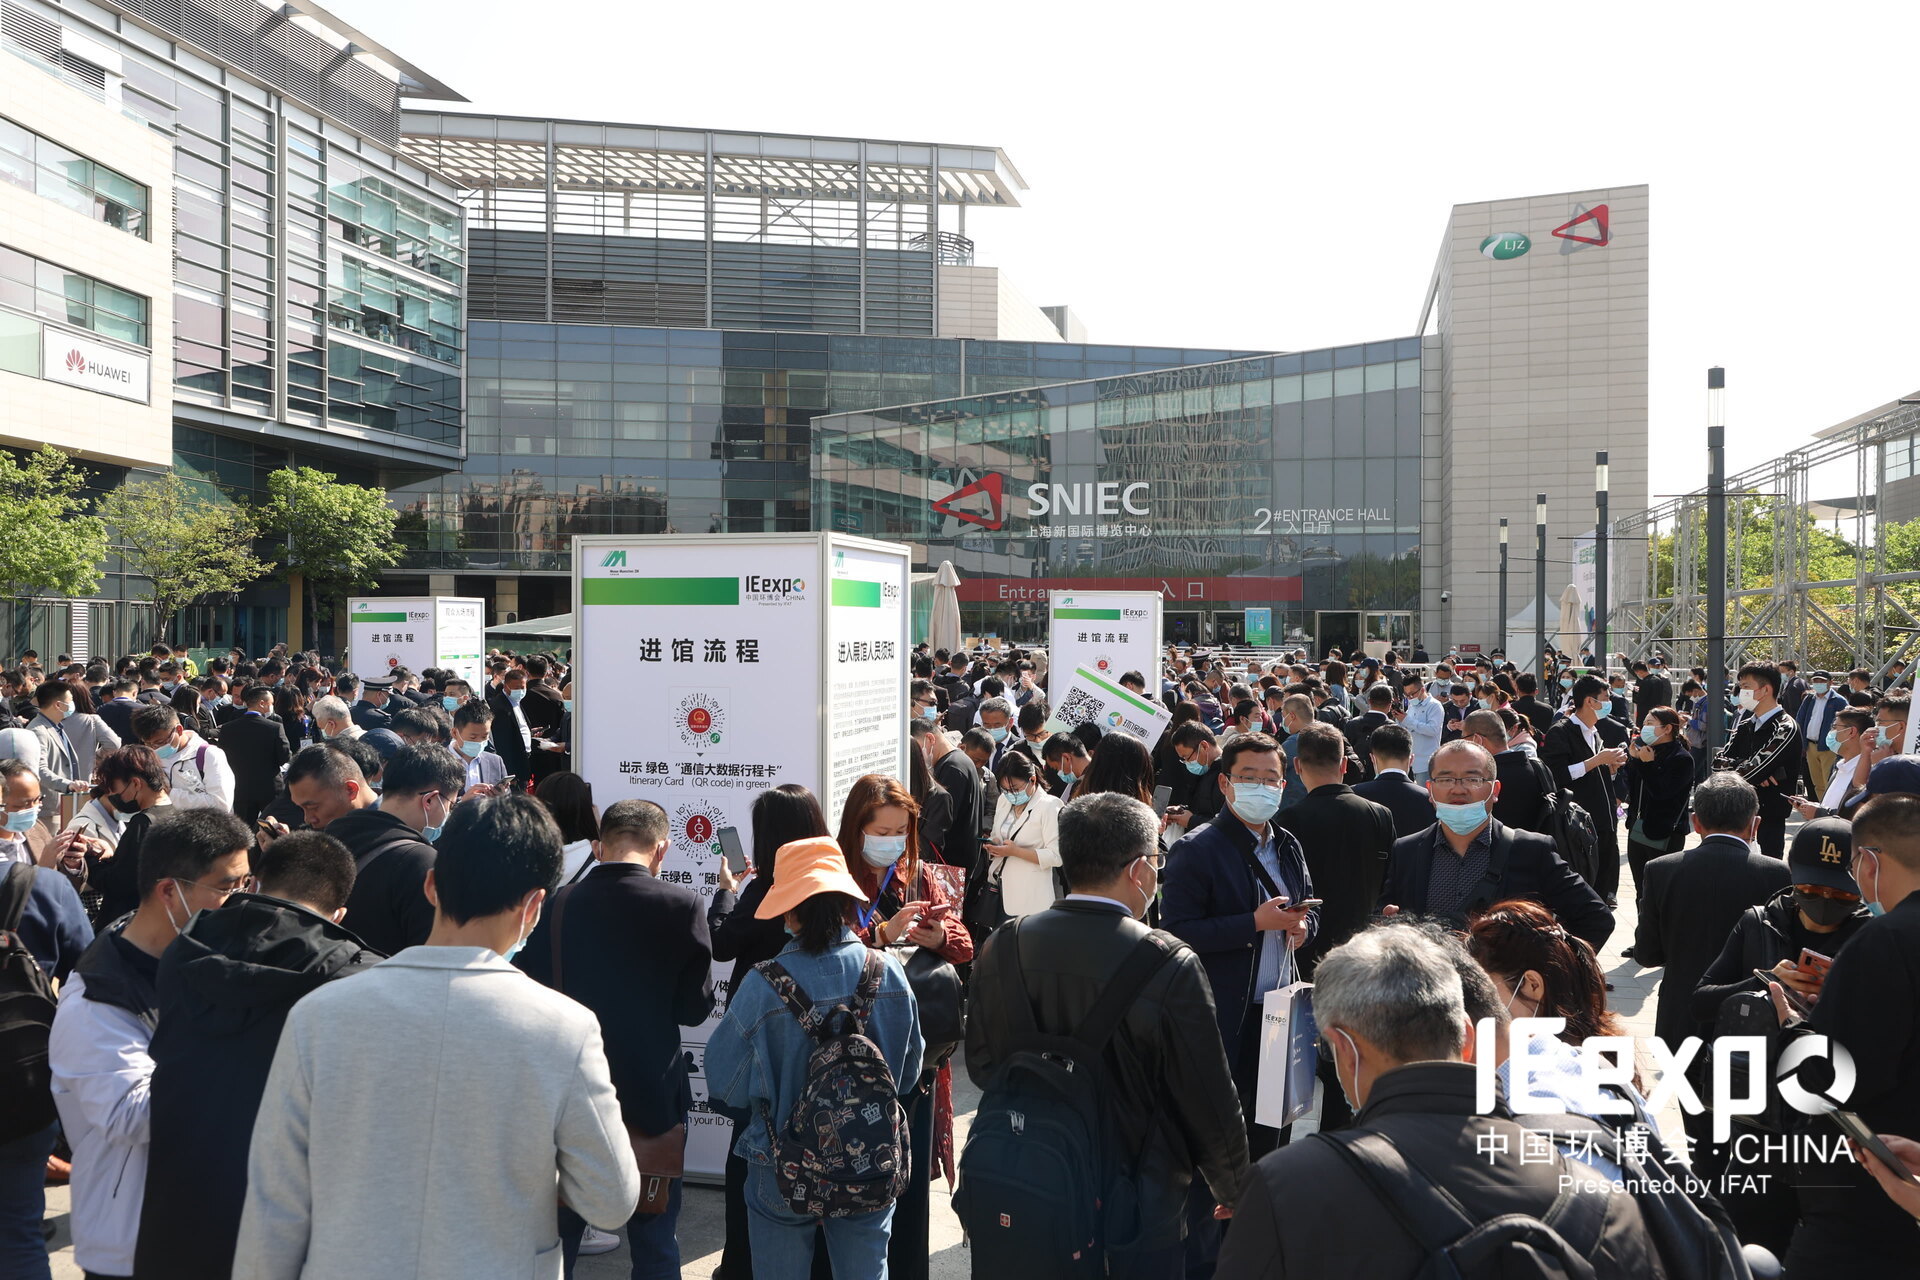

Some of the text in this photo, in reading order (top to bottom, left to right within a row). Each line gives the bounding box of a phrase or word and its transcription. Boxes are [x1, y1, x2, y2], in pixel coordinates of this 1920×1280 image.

[1505, 240, 1525, 251] LJZ
[88, 361, 131, 384] HUAWEI
[1027, 482, 1150, 516] SNIEC
[1358, 508, 1391, 521] HALL
[1026, 523, 1152, 538] 上海新国际博览中心
[1286, 521, 1331, 534] 入口厅
[746, 575, 806, 597] IEexpo
[1000, 585, 1074, 599] Entra
[1161, 581, 1204, 599] 入口
[371, 634, 414, 643] 进馆流程
[1077, 632, 1129, 643] 进馆流程
[640, 638, 760, 663] 进馆流程
[838, 641, 895, 663] 进入展馆人员须知
[619, 761, 642, 774] 出示
[646, 761, 669, 774] 绿色
[629, 776, 664, 788] Itinerary
[664, 777, 684, 786] Card
[710, 778, 734, 788] code)
[736, 779, 744, 787] in
[745, 780, 771, 790] green
[1820, 836, 1841, 863] LA
[694, 1117, 714, 1127] your
[715, 1117, 725, 1126] ID
